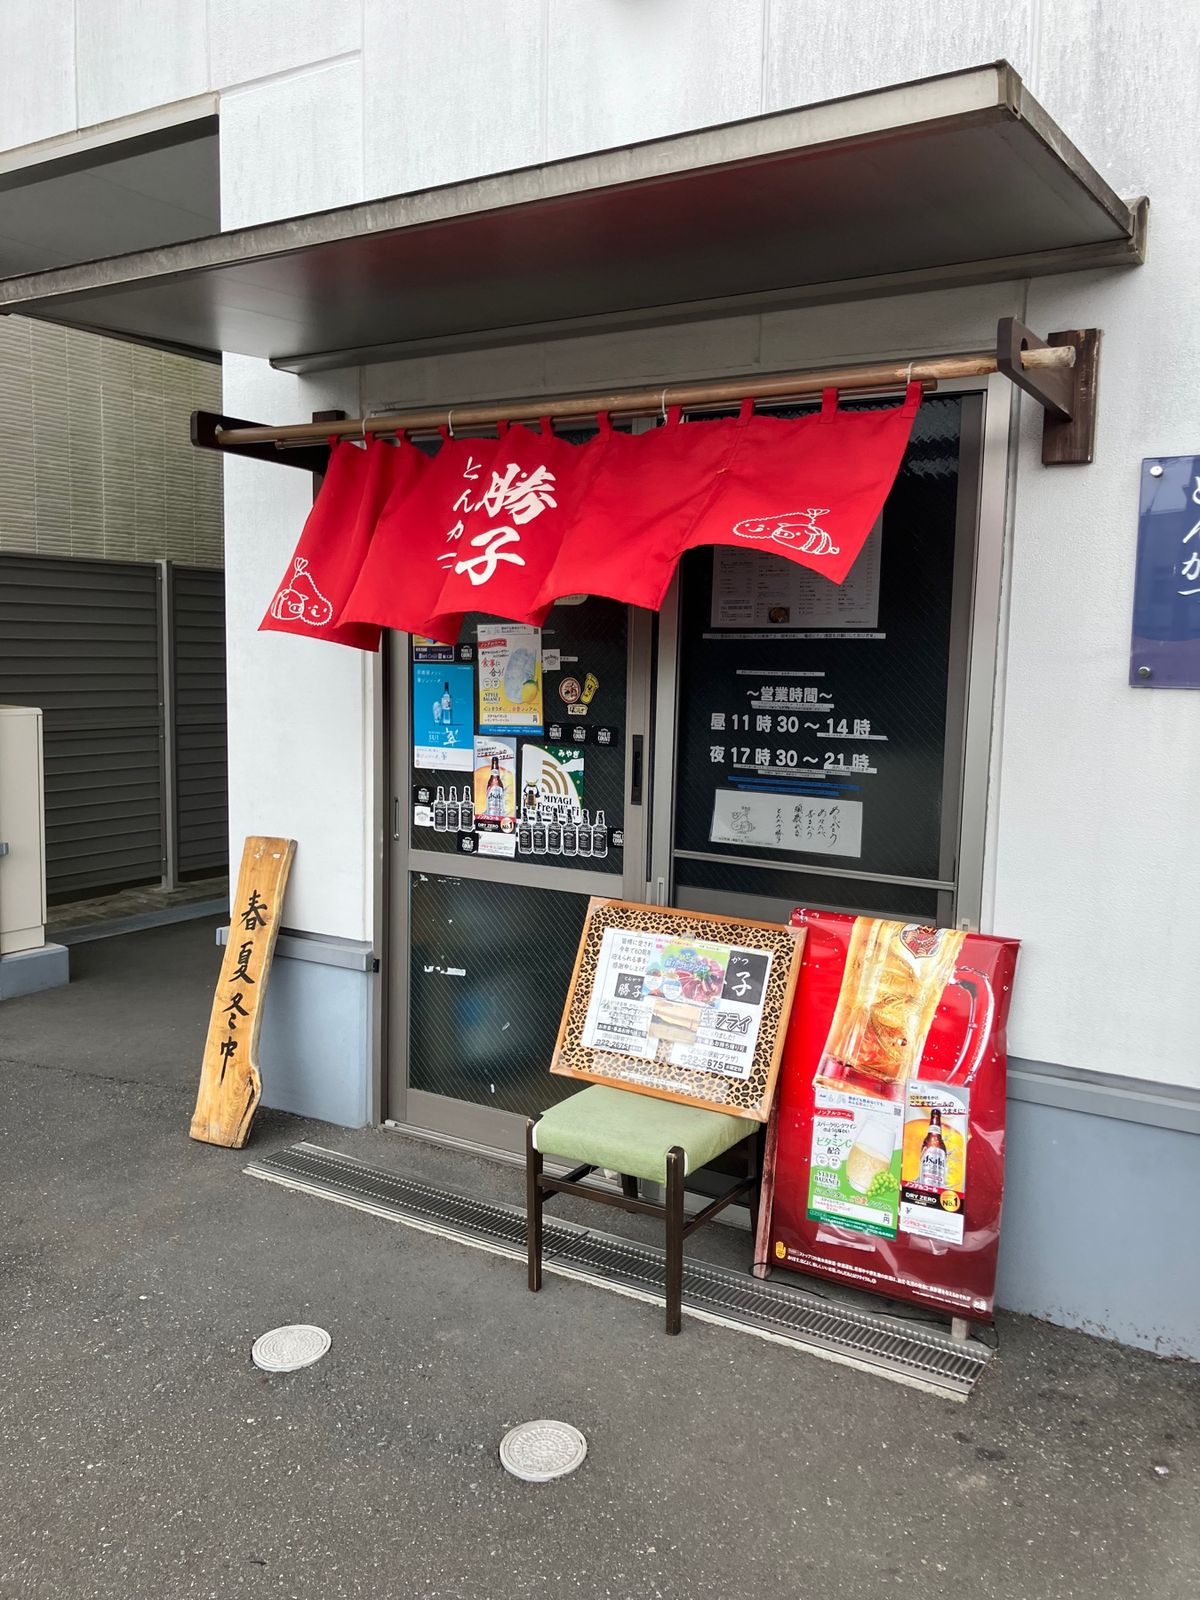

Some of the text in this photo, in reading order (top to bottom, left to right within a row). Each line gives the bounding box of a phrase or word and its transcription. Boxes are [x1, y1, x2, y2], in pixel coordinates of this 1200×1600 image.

[455, 463, 557, 586] 勝子
[558, 750, 580, 758] みやぎ
[544, 795, 572, 805] MIYAGI
[219, 889, 268, 1087] 春夏冬中
[618, 983, 642, 997] 勝子
[816, 1137, 852, 1148] ビタミンC
[827, 1147, 841, 1155] 配合
[922, 1155, 945, 1167] Asahi
[905, 1182, 938, 1193] ノンアルコール
[919, 1195, 937, 1203] ZERO
[942, 1197, 958, 1207] No.1
